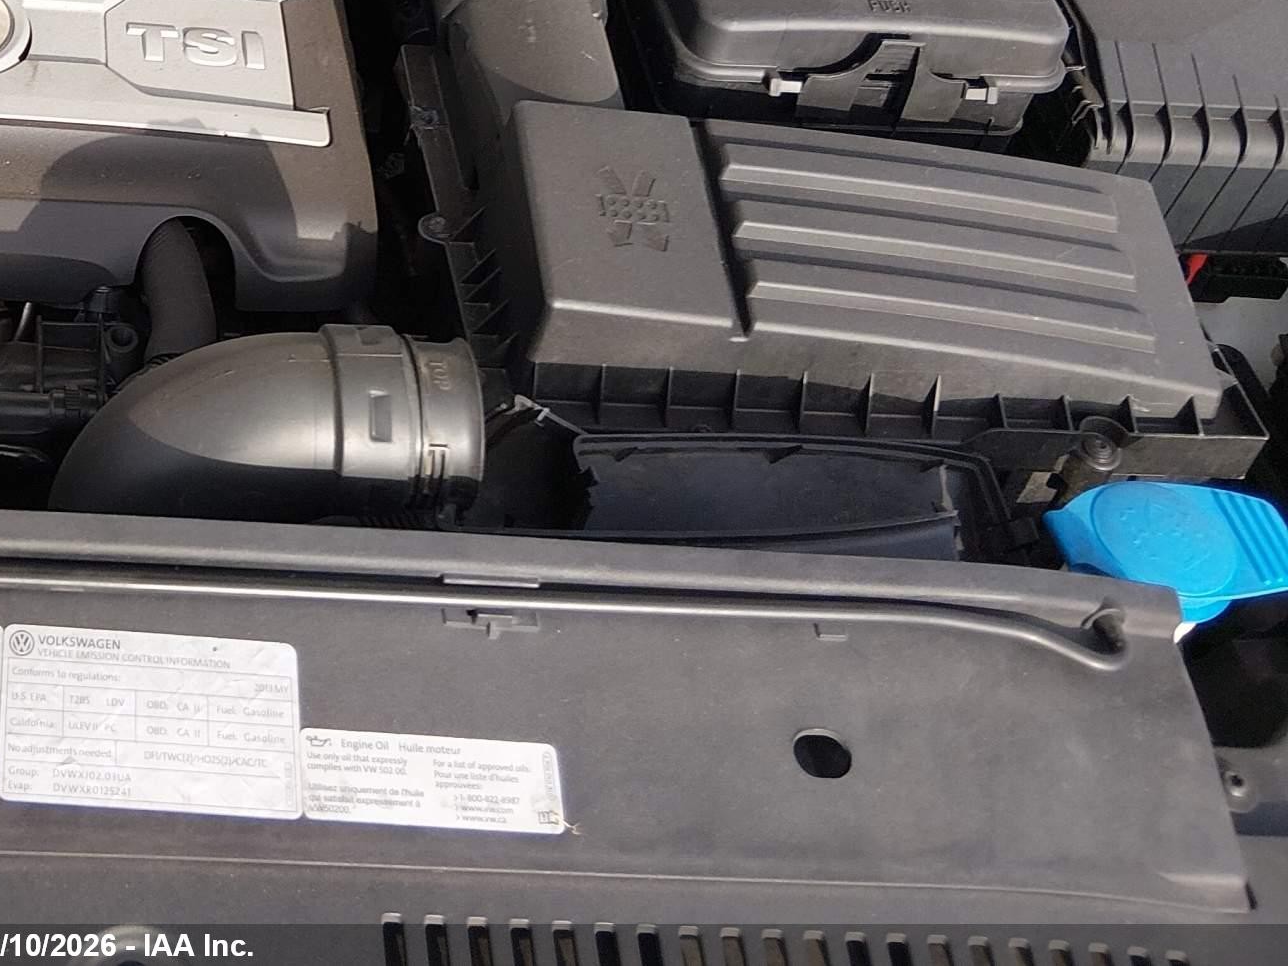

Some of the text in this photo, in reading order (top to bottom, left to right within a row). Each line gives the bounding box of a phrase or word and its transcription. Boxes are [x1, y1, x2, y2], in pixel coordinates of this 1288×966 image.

[126, 23, 265, 70] TSI
[38, 634, 121, 650] VOLKSWAGEN
[38, 648, 231, 669] VEHICLE EMISSION CONTROL INFORMATION
[12, 666, 121, 682] Conforms to regulations:
[243, 707, 285, 718] Gasoline
[217, 730, 286, 744] Fuel: Gasoline
[8, 743, 21, 753] No
[22, 745, 78, 757] adjustments
[341, 738, 461, 755] Engine Oil Huile moteur
[323, 753, 340, 762] only
[353, 754, 370, 762] that
[371, 757, 408, 767] expressly
[432, 759, 445, 768] For
[477, 762, 514, 773] approved
[8, 766, 40, 778] Group:
[307, 762, 342, 772] complies
[344, 764, 362, 772] with
[363, 765, 377, 773] VW
[8, 780, 33, 792] Evap:
